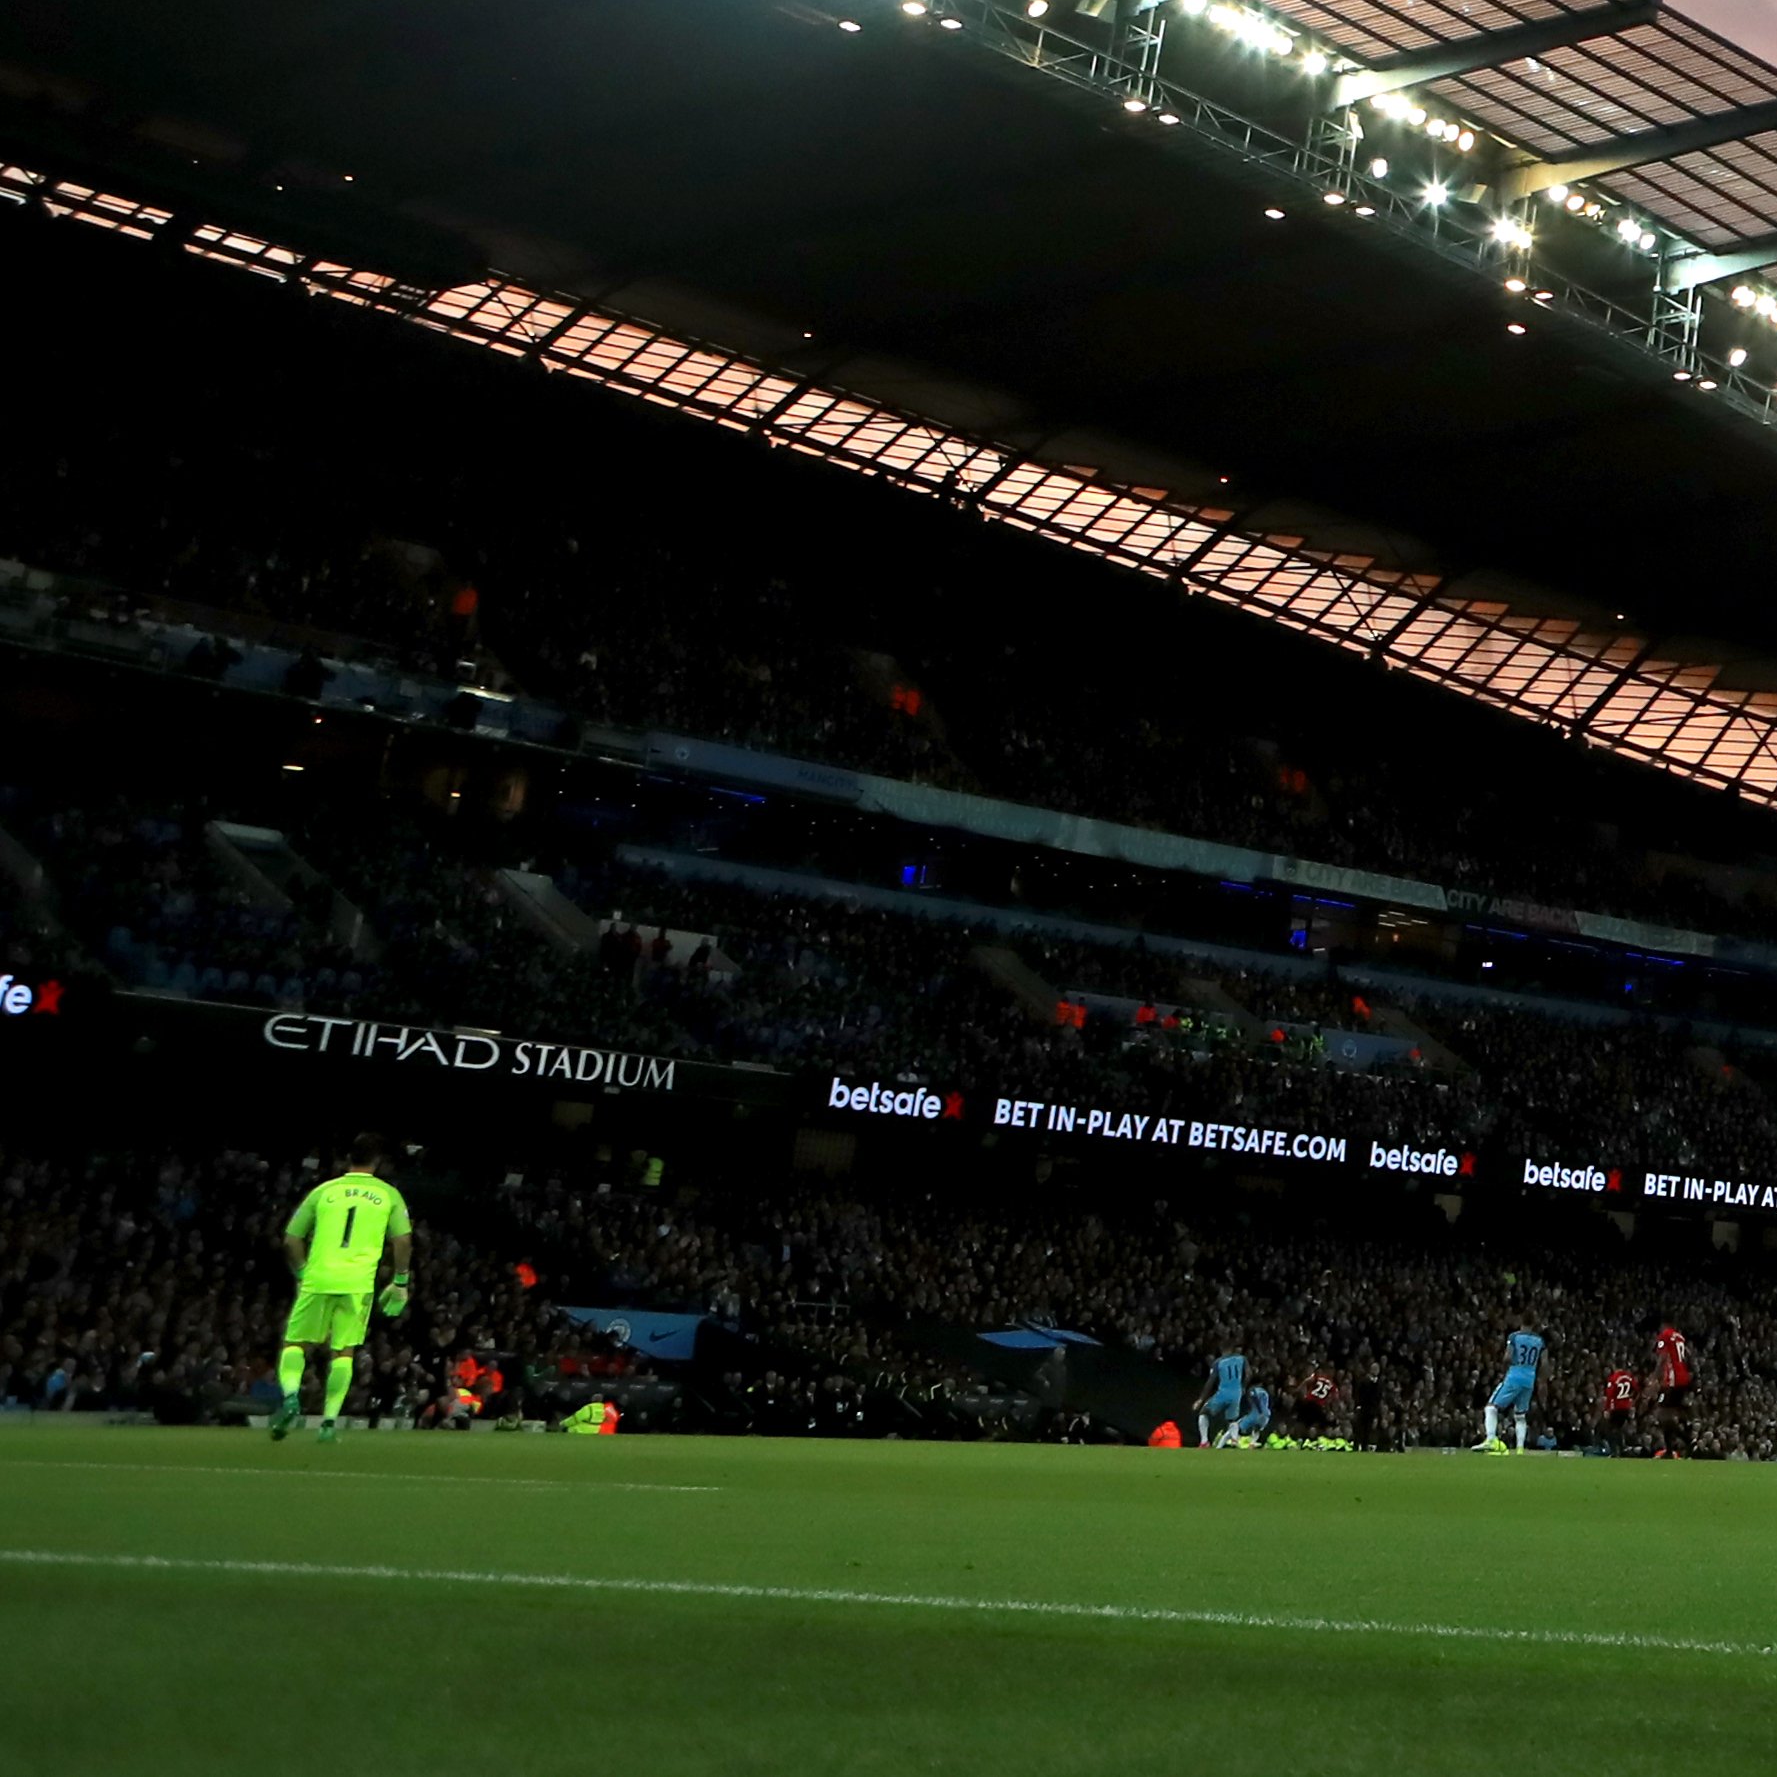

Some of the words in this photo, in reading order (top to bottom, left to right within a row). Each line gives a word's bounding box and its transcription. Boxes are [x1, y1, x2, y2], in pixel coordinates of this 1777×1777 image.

[1447, 888, 1488, 913] CITY
[1488, 896, 1525, 920] ARE
[1527, 904, 1577, 929] BACK
[264, 1014, 500, 1070] ETIHAD
[511, 1041, 675, 1090] STADIUM
[828, 1076, 942, 1119] betsafe
[994, 1098, 1044, 1128] BET
[1047, 1105, 1149, 1140] IN-PLAY
[1151, 1117, 1185, 1144] AT
[1188, 1122, 1346, 1163] BETSAFE.COM
[1369, 1140, 1458, 1176] betsafe
[1523, 1158, 1606, 1192] betsafe
[345, 1188, 382, 1205] BRAVO
[1644, 1173, 1681, 1198] BET
[1683, 1177, 1760, 1206] IN-PLAY
[340, 1206, 357, 1248] 1
[1519, 1344, 1539, 1366] 30
[1227, 1365, 1239, 1380] 11
[1310, 1380, 1333, 1400] 25
[1616, 1382, 1631, 1399] 22
